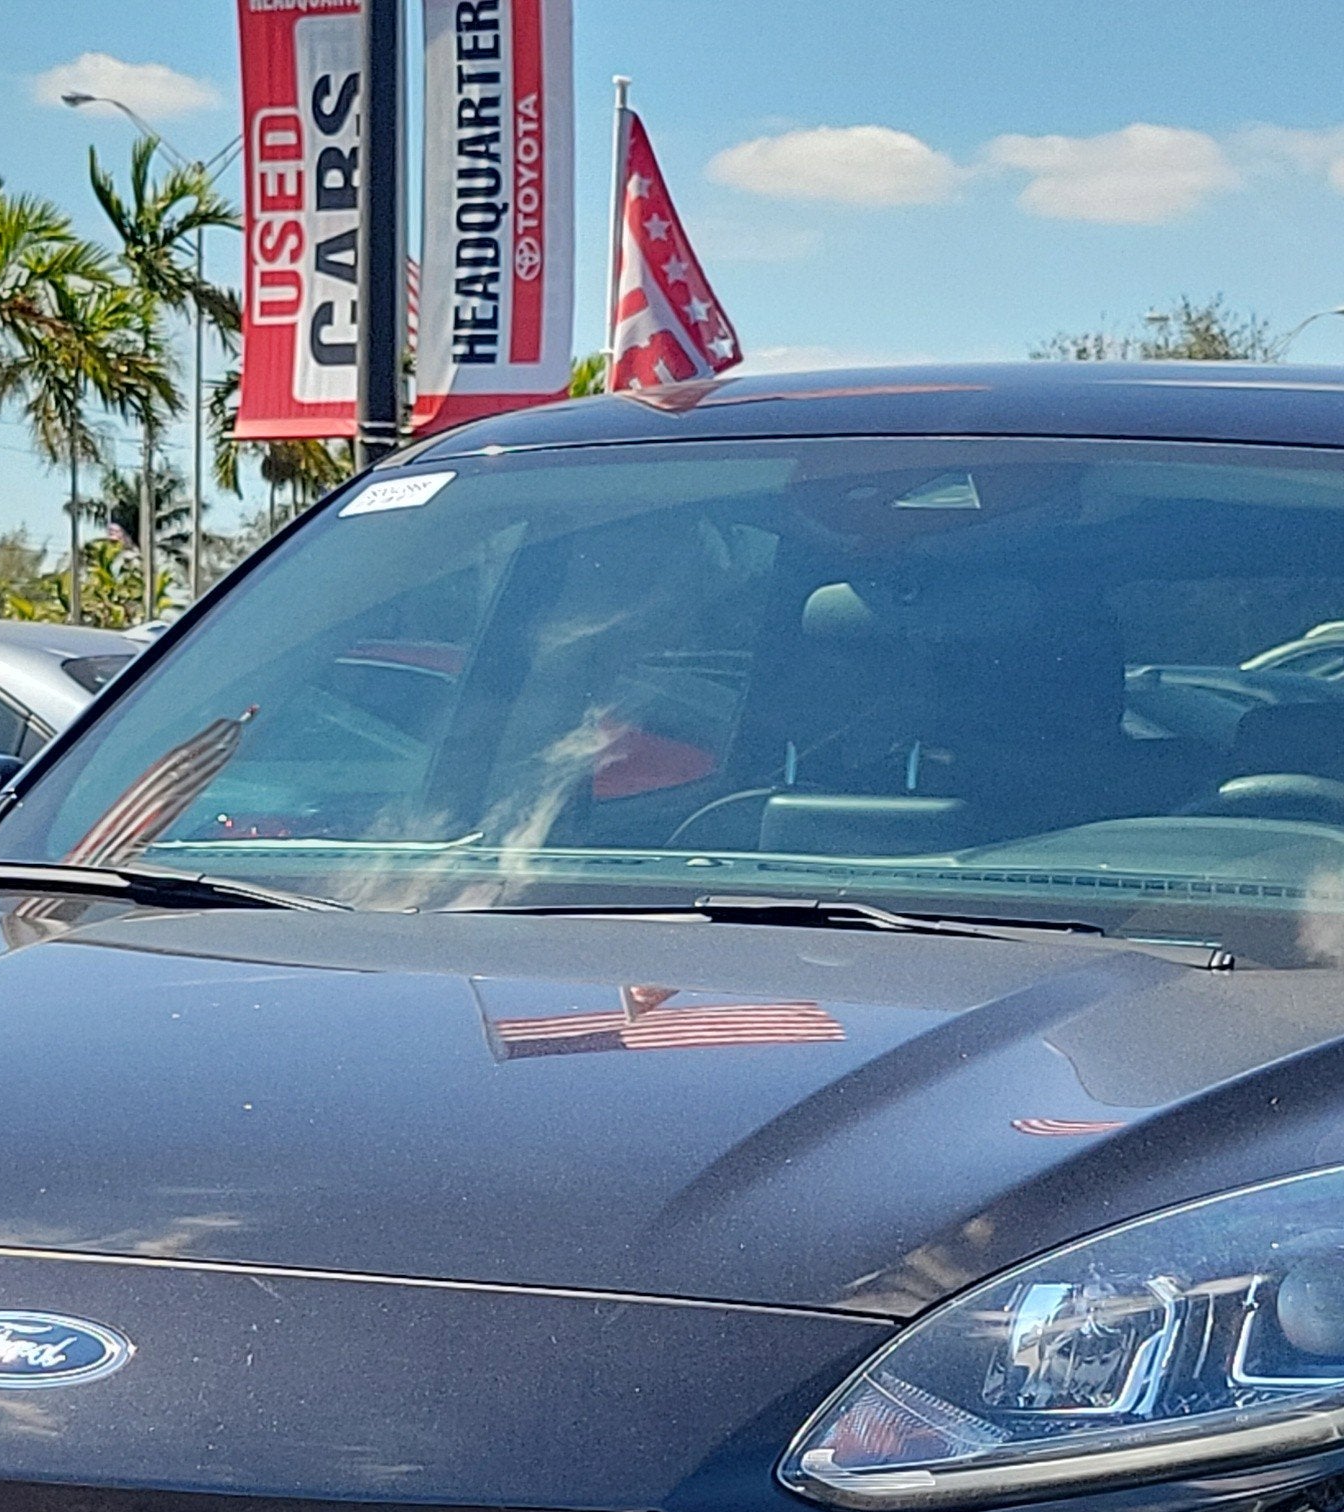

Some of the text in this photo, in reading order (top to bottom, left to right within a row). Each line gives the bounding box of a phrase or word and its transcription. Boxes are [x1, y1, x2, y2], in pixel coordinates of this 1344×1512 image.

[257, 113, 304, 319] USED
[310, 71, 361, 367] CARS
[453, 0, 509, 365] HEADQUARTER
[516, 92, 540, 236] TOYOTA
